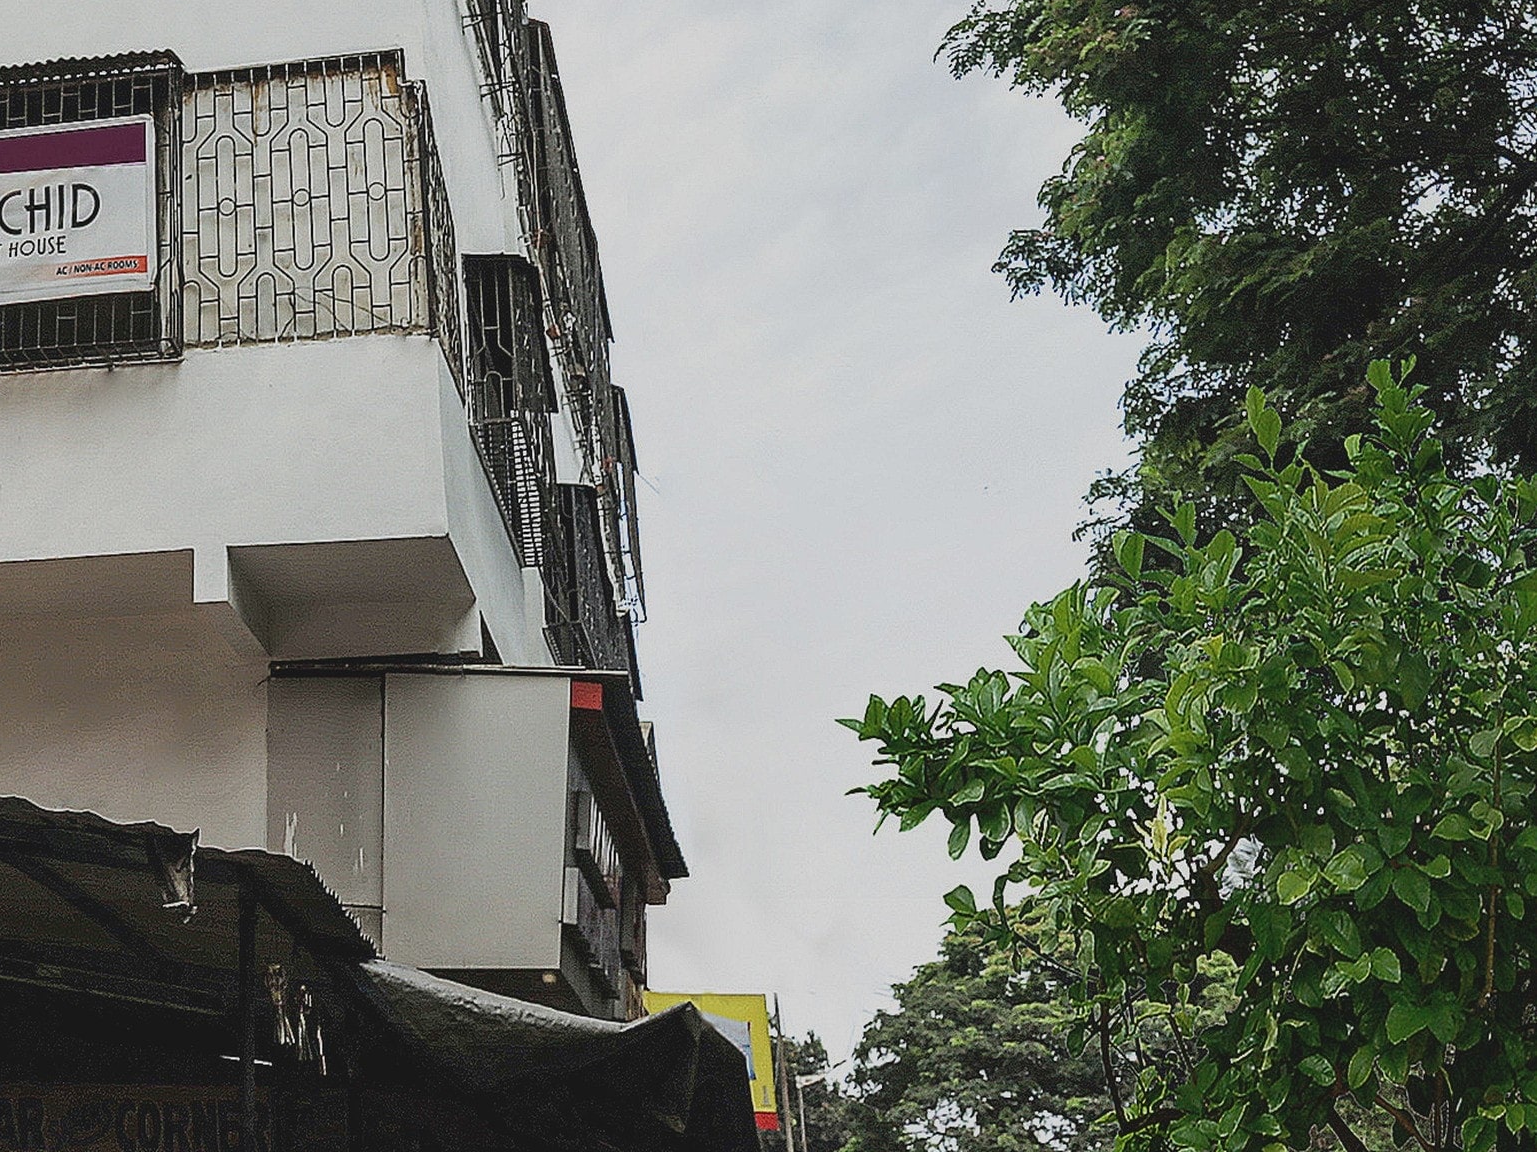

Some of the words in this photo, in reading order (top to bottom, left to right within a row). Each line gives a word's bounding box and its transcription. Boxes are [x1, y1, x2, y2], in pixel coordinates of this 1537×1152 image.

[8, 236, 67, 257] HOUSE
[56, 266, 68, 275] AC
[74, 261, 105, 273] NON-AC
[107, 259, 138, 271] ROOMS
